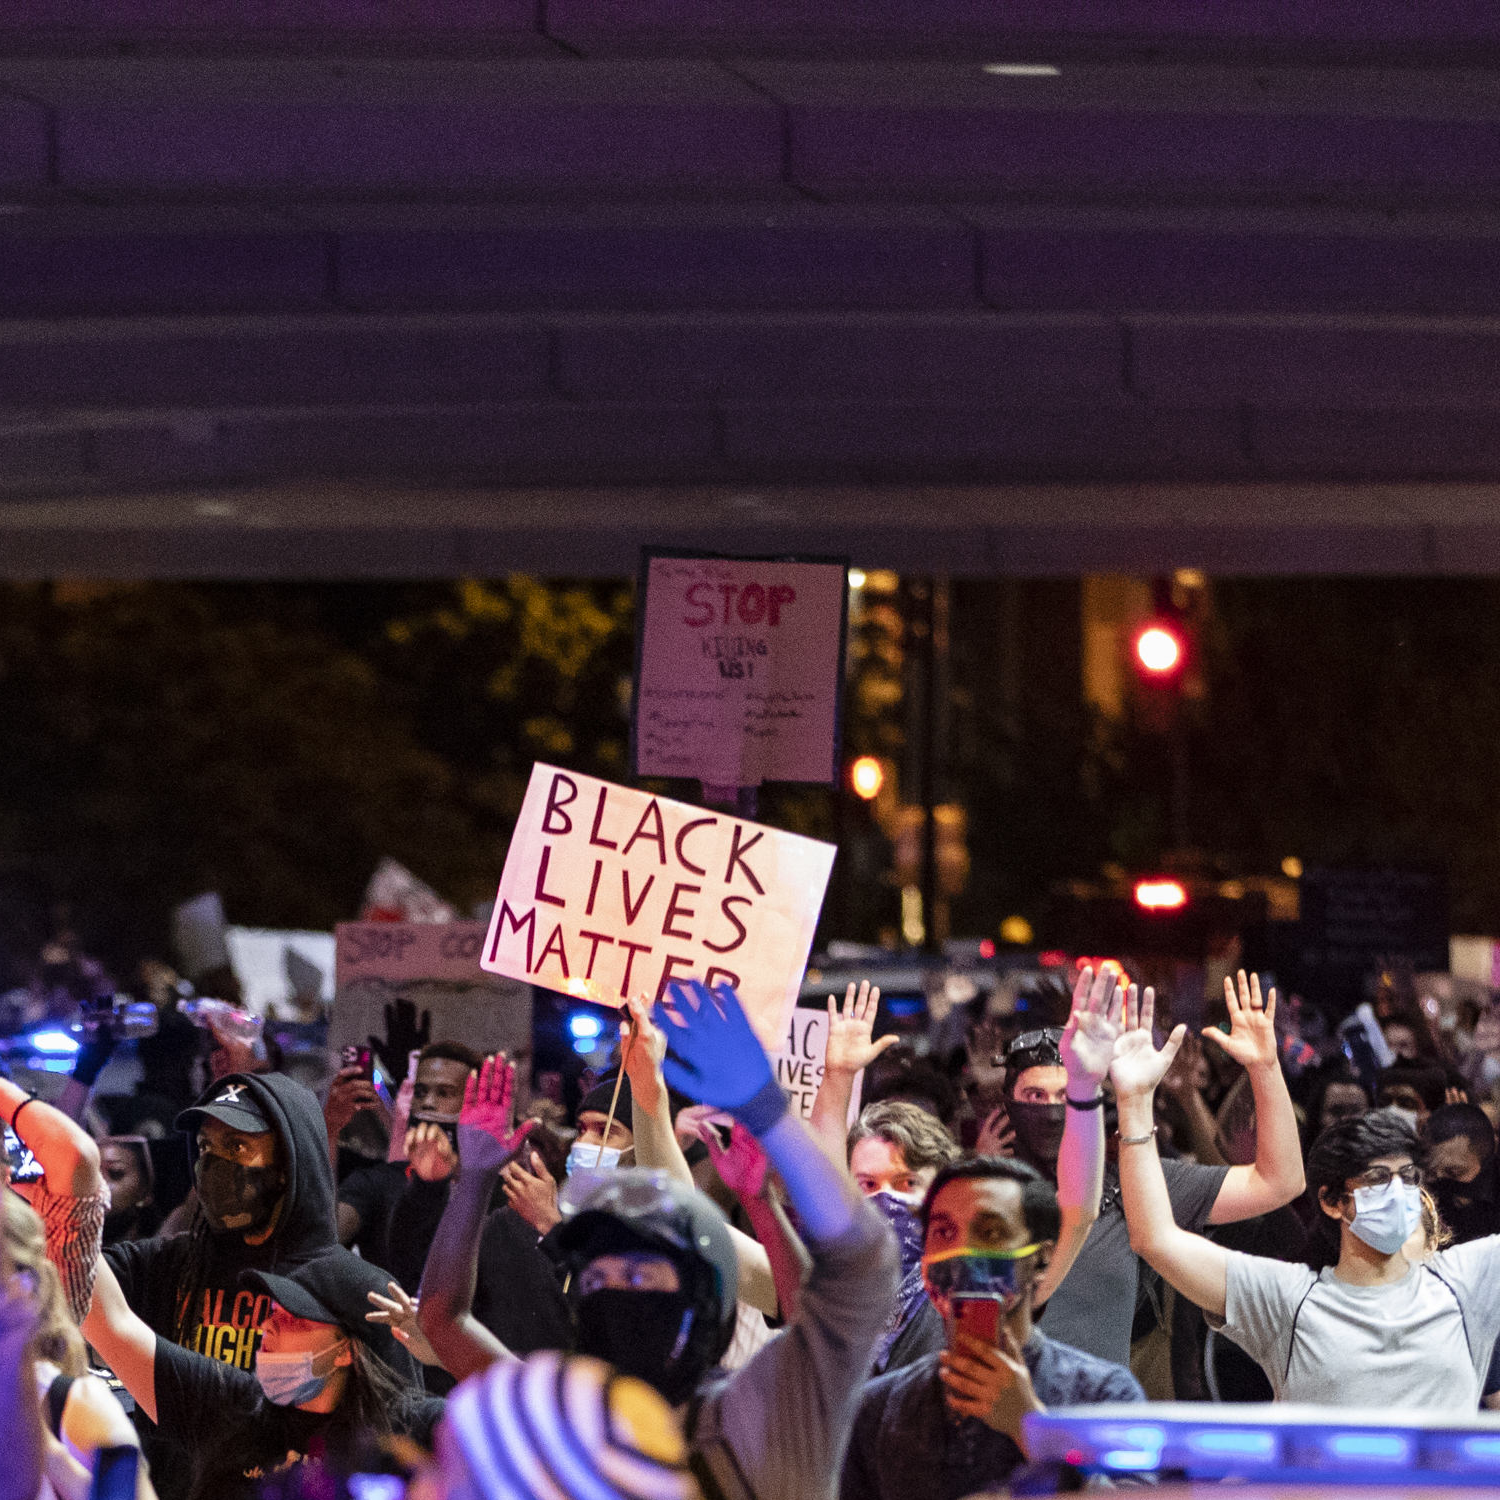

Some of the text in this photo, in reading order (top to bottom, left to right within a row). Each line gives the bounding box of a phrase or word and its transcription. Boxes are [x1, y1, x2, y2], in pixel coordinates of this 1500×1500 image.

[683, 581, 797, 628] STOP
[541, 773, 766, 895] BLACK
[534, 845, 753, 954] LIVES
[215, 1083, 248, 1102] X
